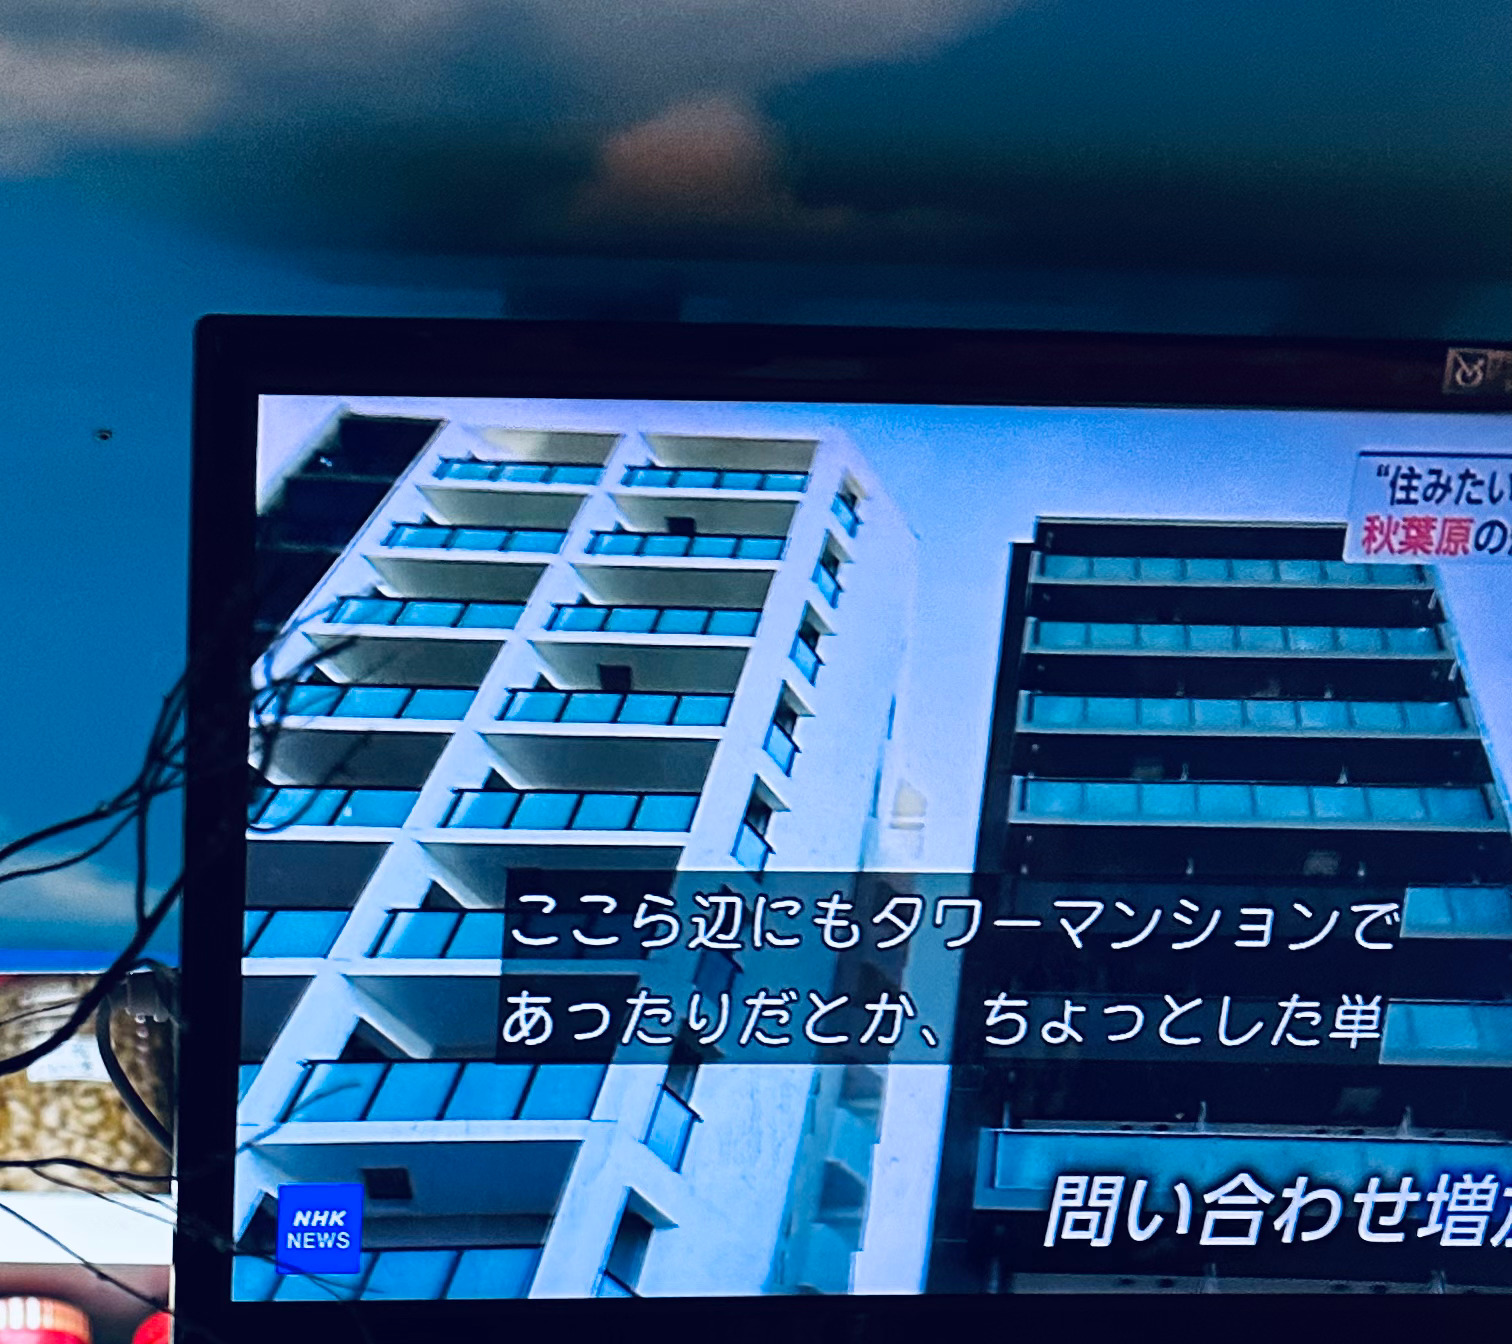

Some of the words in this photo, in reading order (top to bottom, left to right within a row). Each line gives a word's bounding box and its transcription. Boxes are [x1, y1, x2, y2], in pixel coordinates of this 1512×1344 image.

[1362, 513, 1512, 557] 秋葉原の
[512, 893, 1400, 950] ここら辺にもタワーマンションで
[502, 992, 1383, 1048] あったりだとか、ちょっとした単
[292, 1210, 347, 1227] NHK
[1043, 1172, 1512, 1248] 問い合わせ増
[287, 1231, 351, 1249] NEWS
